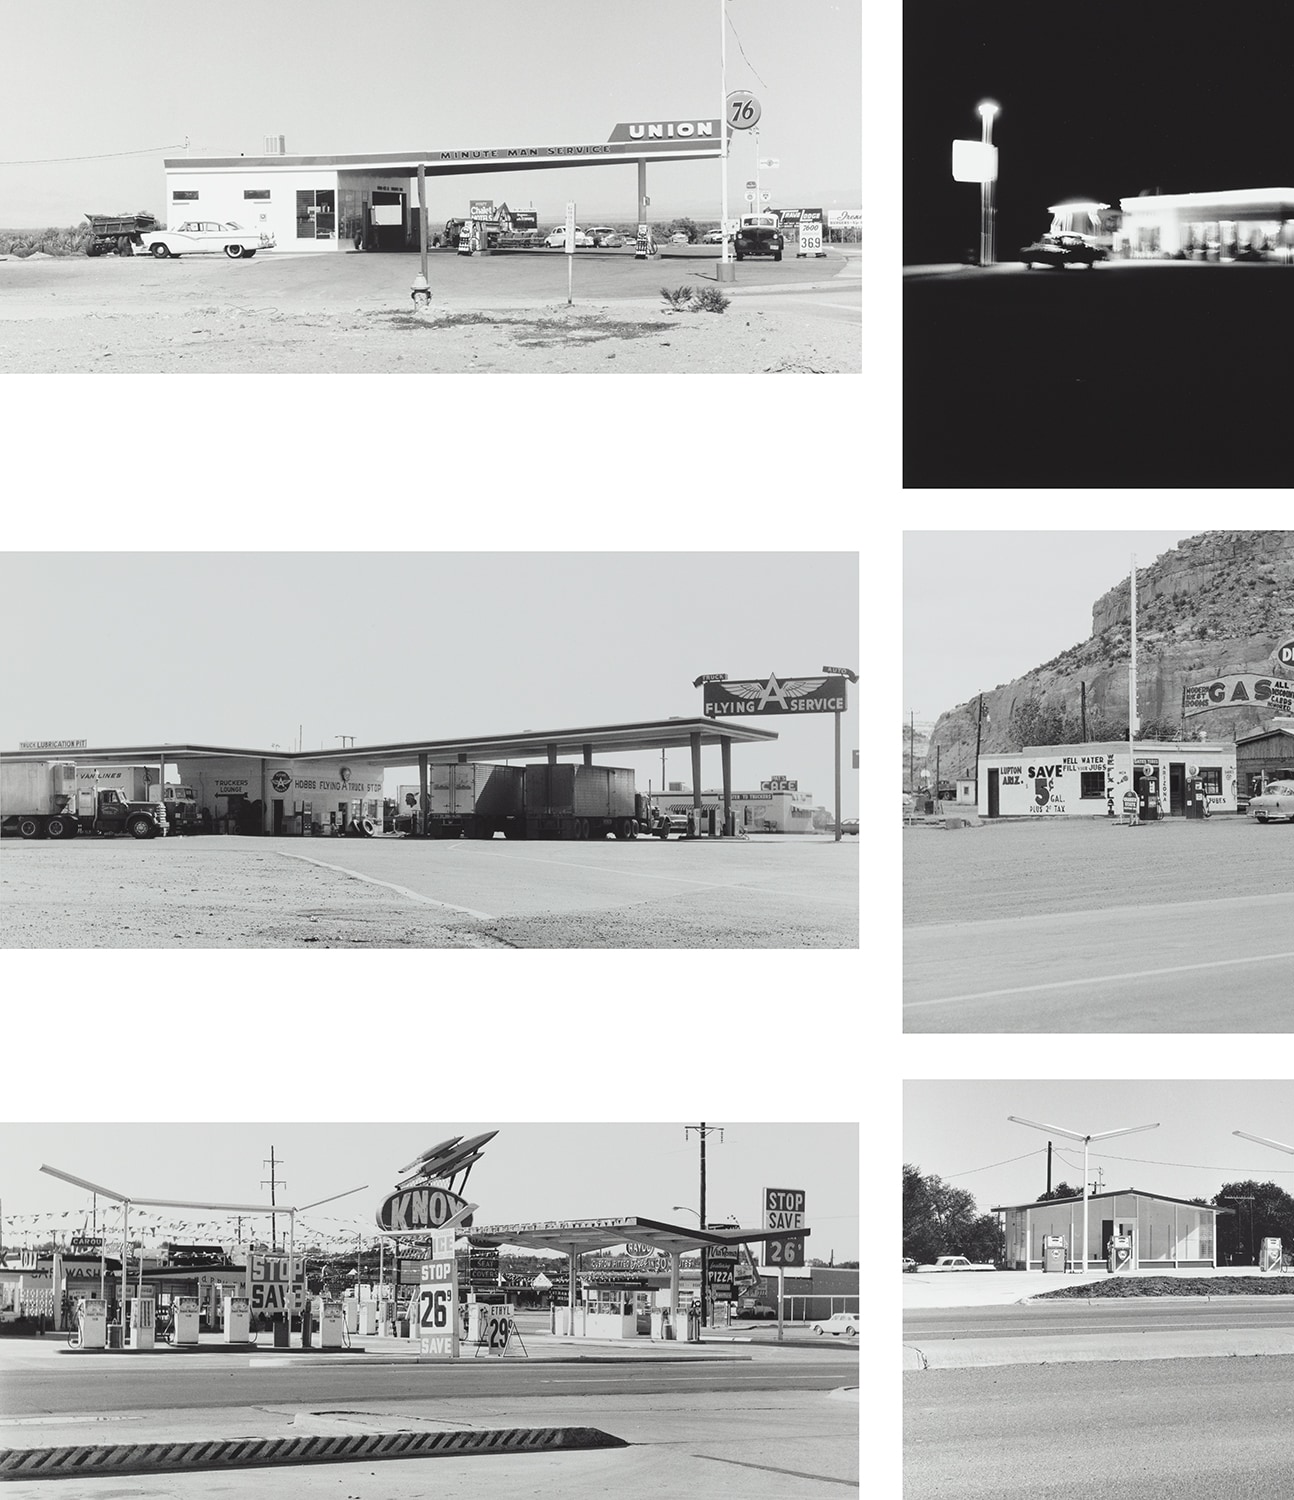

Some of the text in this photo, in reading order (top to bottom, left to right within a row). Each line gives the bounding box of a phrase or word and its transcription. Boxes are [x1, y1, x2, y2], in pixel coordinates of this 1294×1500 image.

[732, 100, 754, 121] 76
[629, 122, 712, 139] UNION
[440, 146, 611, 160] MINUTE MAN SERVICE
[827, 667, 847, 675] AUTO
[1208, 679, 1272, 703] GAS
[1274, 681, 1290, 690] ALL
[705, 672, 844, 714] FLYING A SERVICE
[37, 740, 74, 749] LUBRICATION
[1063, 756, 1104, 765] WELL WATER
[1000, 767, 1022, 775] LUPTON
[1028, 765, 1063, 779] SAVE
[294, 780, 317, 790] HOBBS
[319, 781, 341, 791] FLYING
[348, 783, 364, 792] TRUCK
[367, 784, 382, 793] STOP
[761, 780, 797, 791] CAFE
[1002, 776, 1024, 785] ARIZ.
[1050, 795, 1065, 803] GAL.
[769, 1191, 803, 1211] STOP
[391, 1190, 465, 1231] KNOX
[769, 1212, 802, 1229] SAVE
[771, 1241, 796, 1263] 26
[66, 1267, 101, 1277] WASH
[253, 1257, 305, 1281] STOP
[421, 1263, 451, 1281] STOP
[472, 1270, 499, 1278] COVERS
[708, 1271, 733, 1283] PIZZA
[252, 1285, 303, 1309] SAVE
[421, 1290, 447, 1328] 26
[491, 1306, 511, 1316] ETHYL
[490, 1318, 509, 1348] 29
[421, 1338, 453, 1355] SAVE
